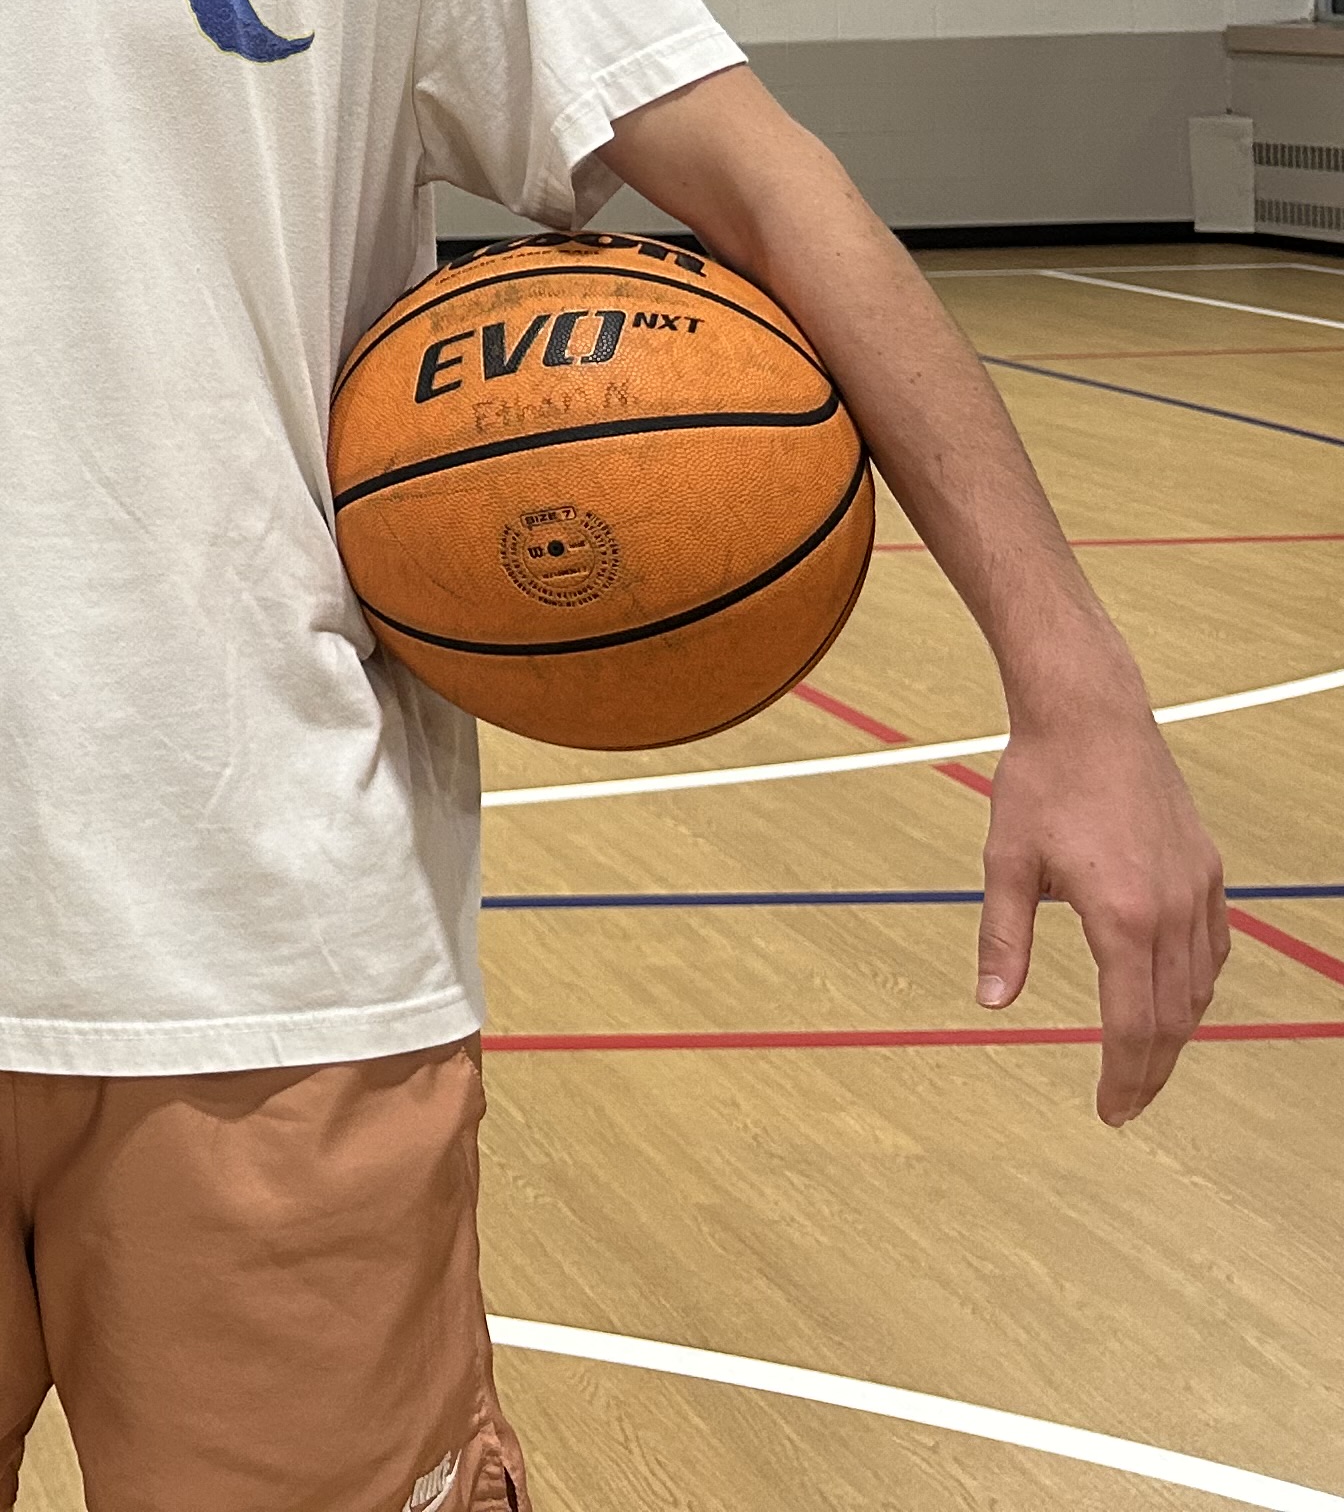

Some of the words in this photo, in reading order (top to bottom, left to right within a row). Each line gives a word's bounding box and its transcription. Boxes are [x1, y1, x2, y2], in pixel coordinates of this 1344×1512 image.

[414, 310, 627, 405] EVO
[632, 311, 706, 334] NXT
[562, 509, 572, 519] 7
